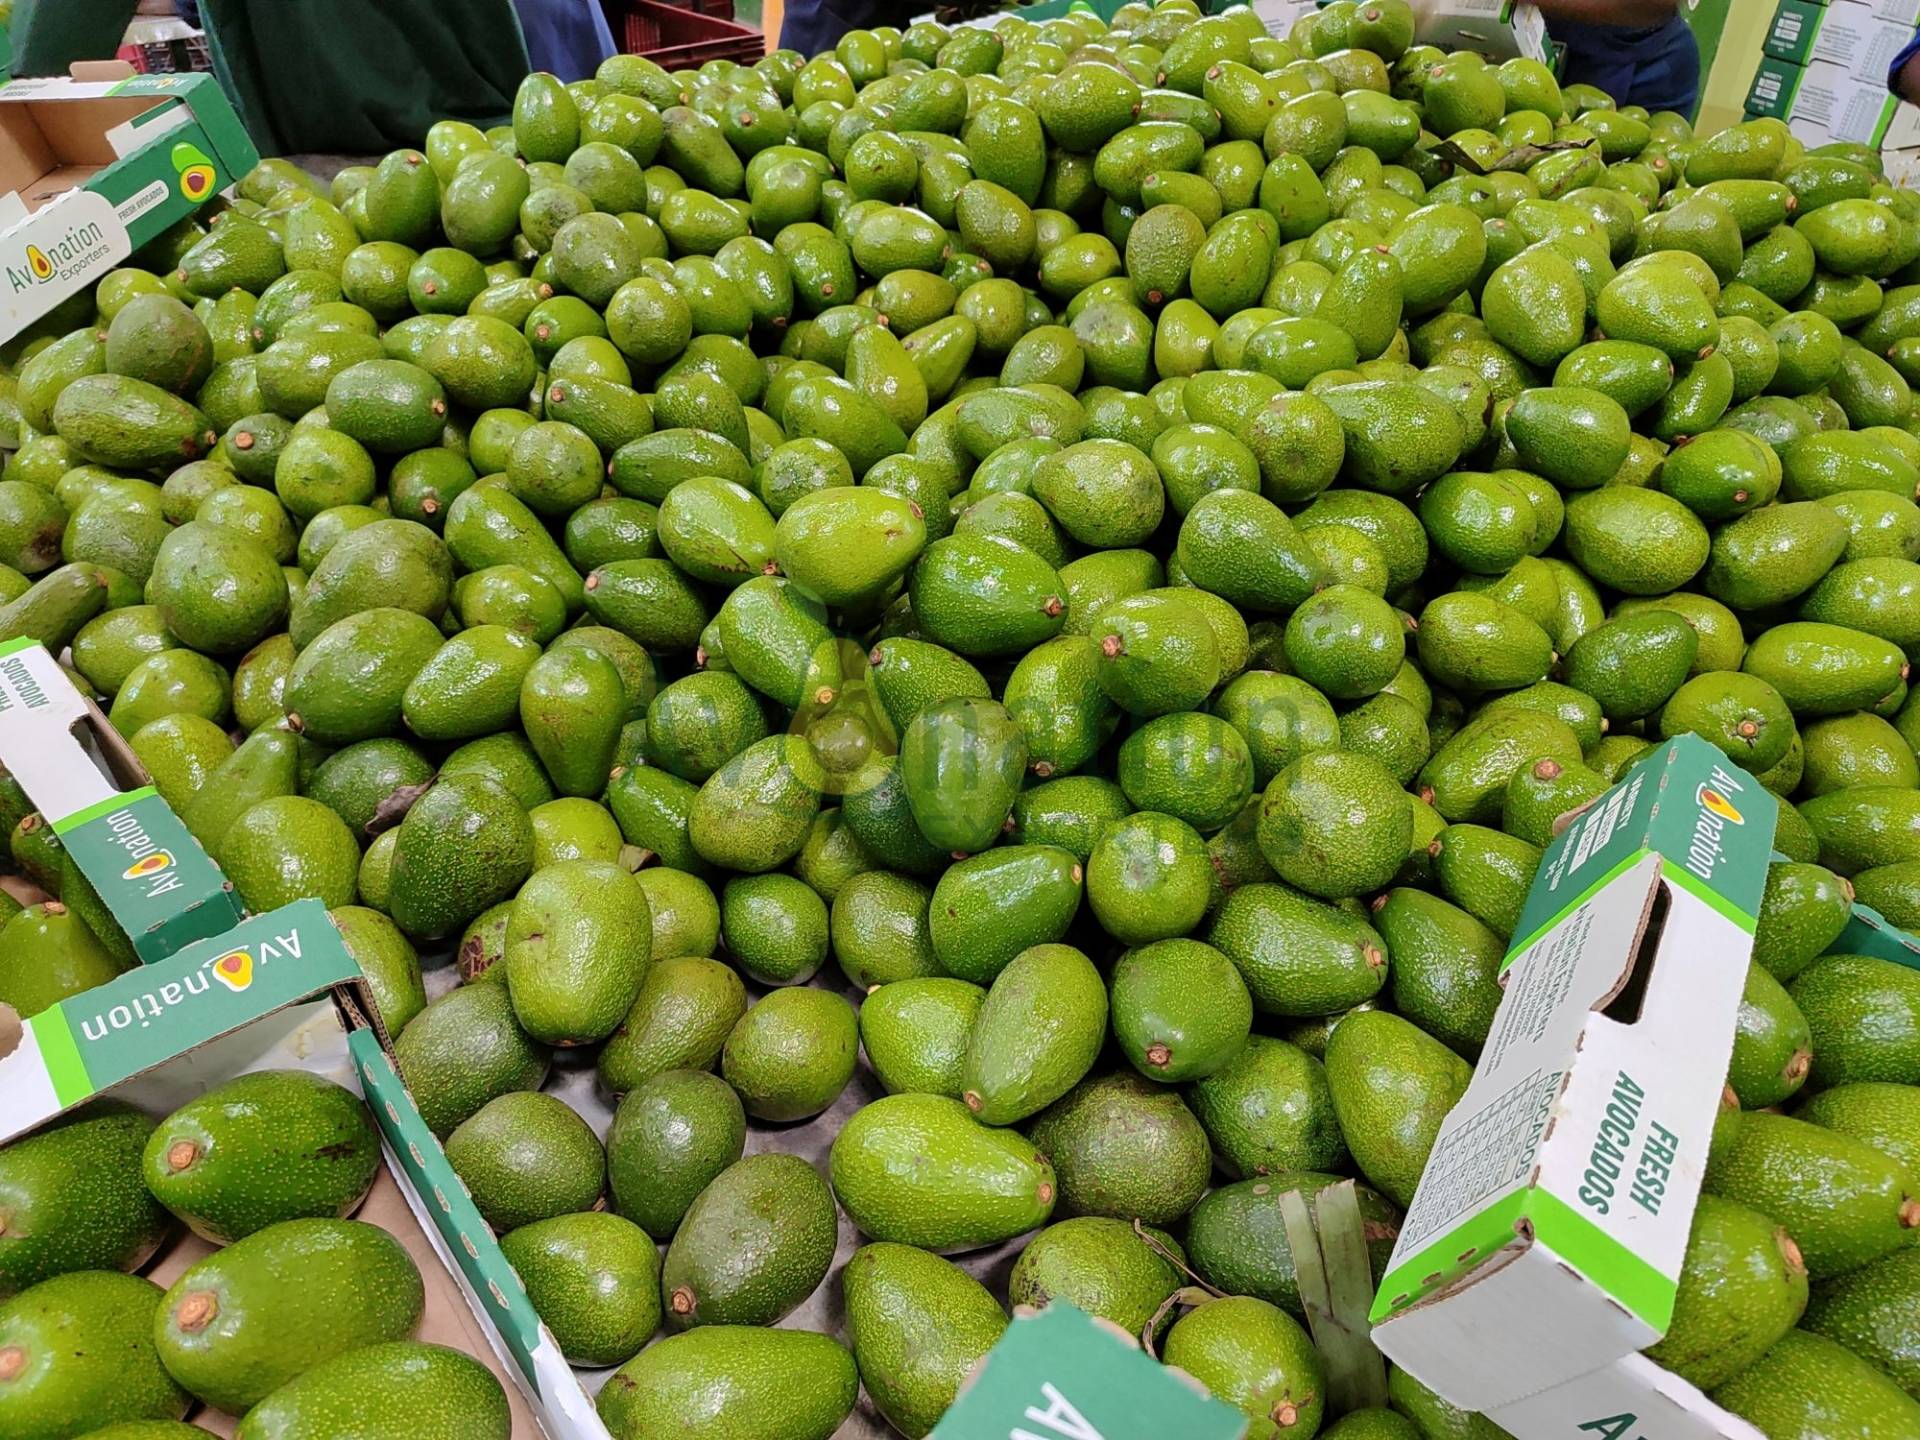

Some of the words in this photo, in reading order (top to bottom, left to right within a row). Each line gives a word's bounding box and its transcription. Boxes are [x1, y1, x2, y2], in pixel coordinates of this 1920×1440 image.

[60, 243, 111, 282] Exporters
[0, 657, 50, 709] AVOCADOS
[1514, 1071, 1562, 1180] AVOCADOS
[1578, 1070, 1645, 1216] AVOCADOS
[1629, 1120, 1680, 1217] FRESH
